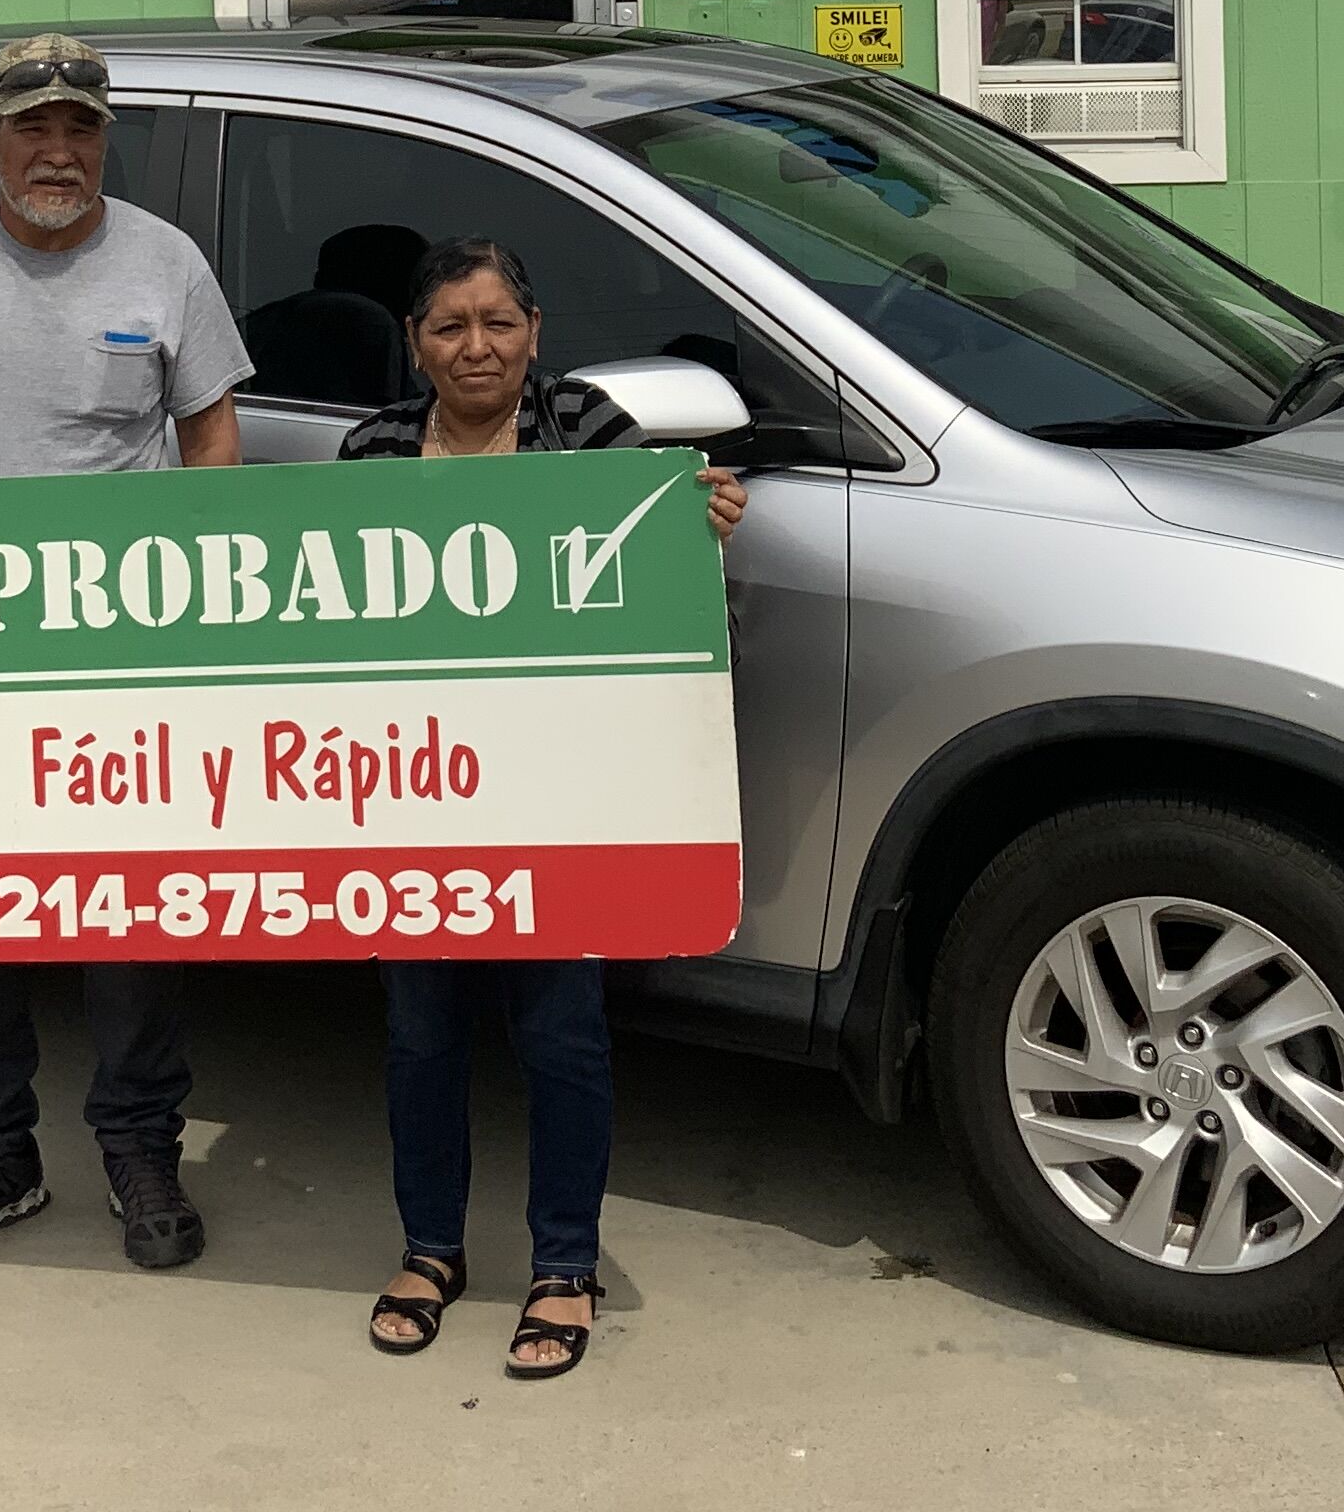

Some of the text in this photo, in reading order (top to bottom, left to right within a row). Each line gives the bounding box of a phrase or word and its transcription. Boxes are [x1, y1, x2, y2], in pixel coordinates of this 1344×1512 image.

[830, 10, 888, 25] SMILE!
[852, 53, 864, 63] ON
[867, 52, 899, 63] CAMERA
[31, 715, 480, 829] Fácil y Rápido
